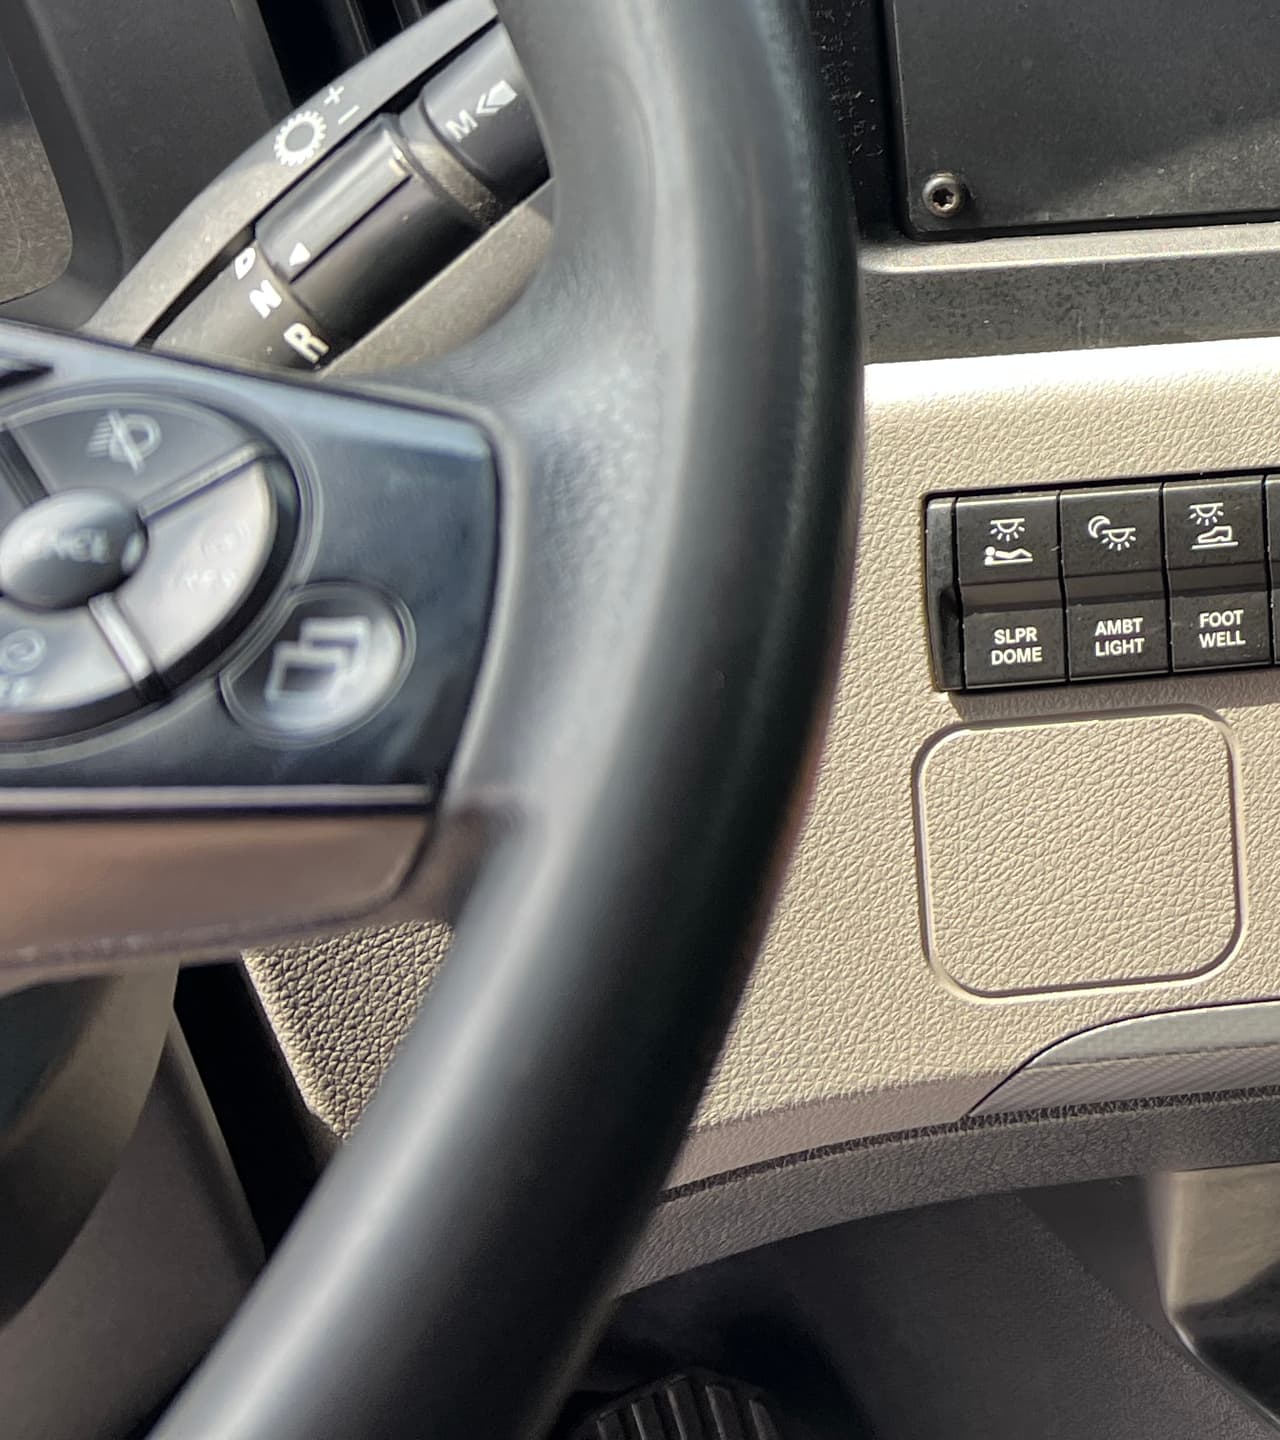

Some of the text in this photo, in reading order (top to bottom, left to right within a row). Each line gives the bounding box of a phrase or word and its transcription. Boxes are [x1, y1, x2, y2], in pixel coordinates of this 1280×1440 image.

[445, 109, 478, 143] M
[249, 279, 282, 318] N
[283, 323, 330, 364] R
[1094, 617, 1144, 637] AMBT
[1199, 609, 1245, 629] FOOT
[993, 626, 1038, 645] SLPR
[1198, 629, 1246, 649] WELL
[990, 646, 1043, 666] DOME
[1094, 637, 1145, 658] LIGHT
